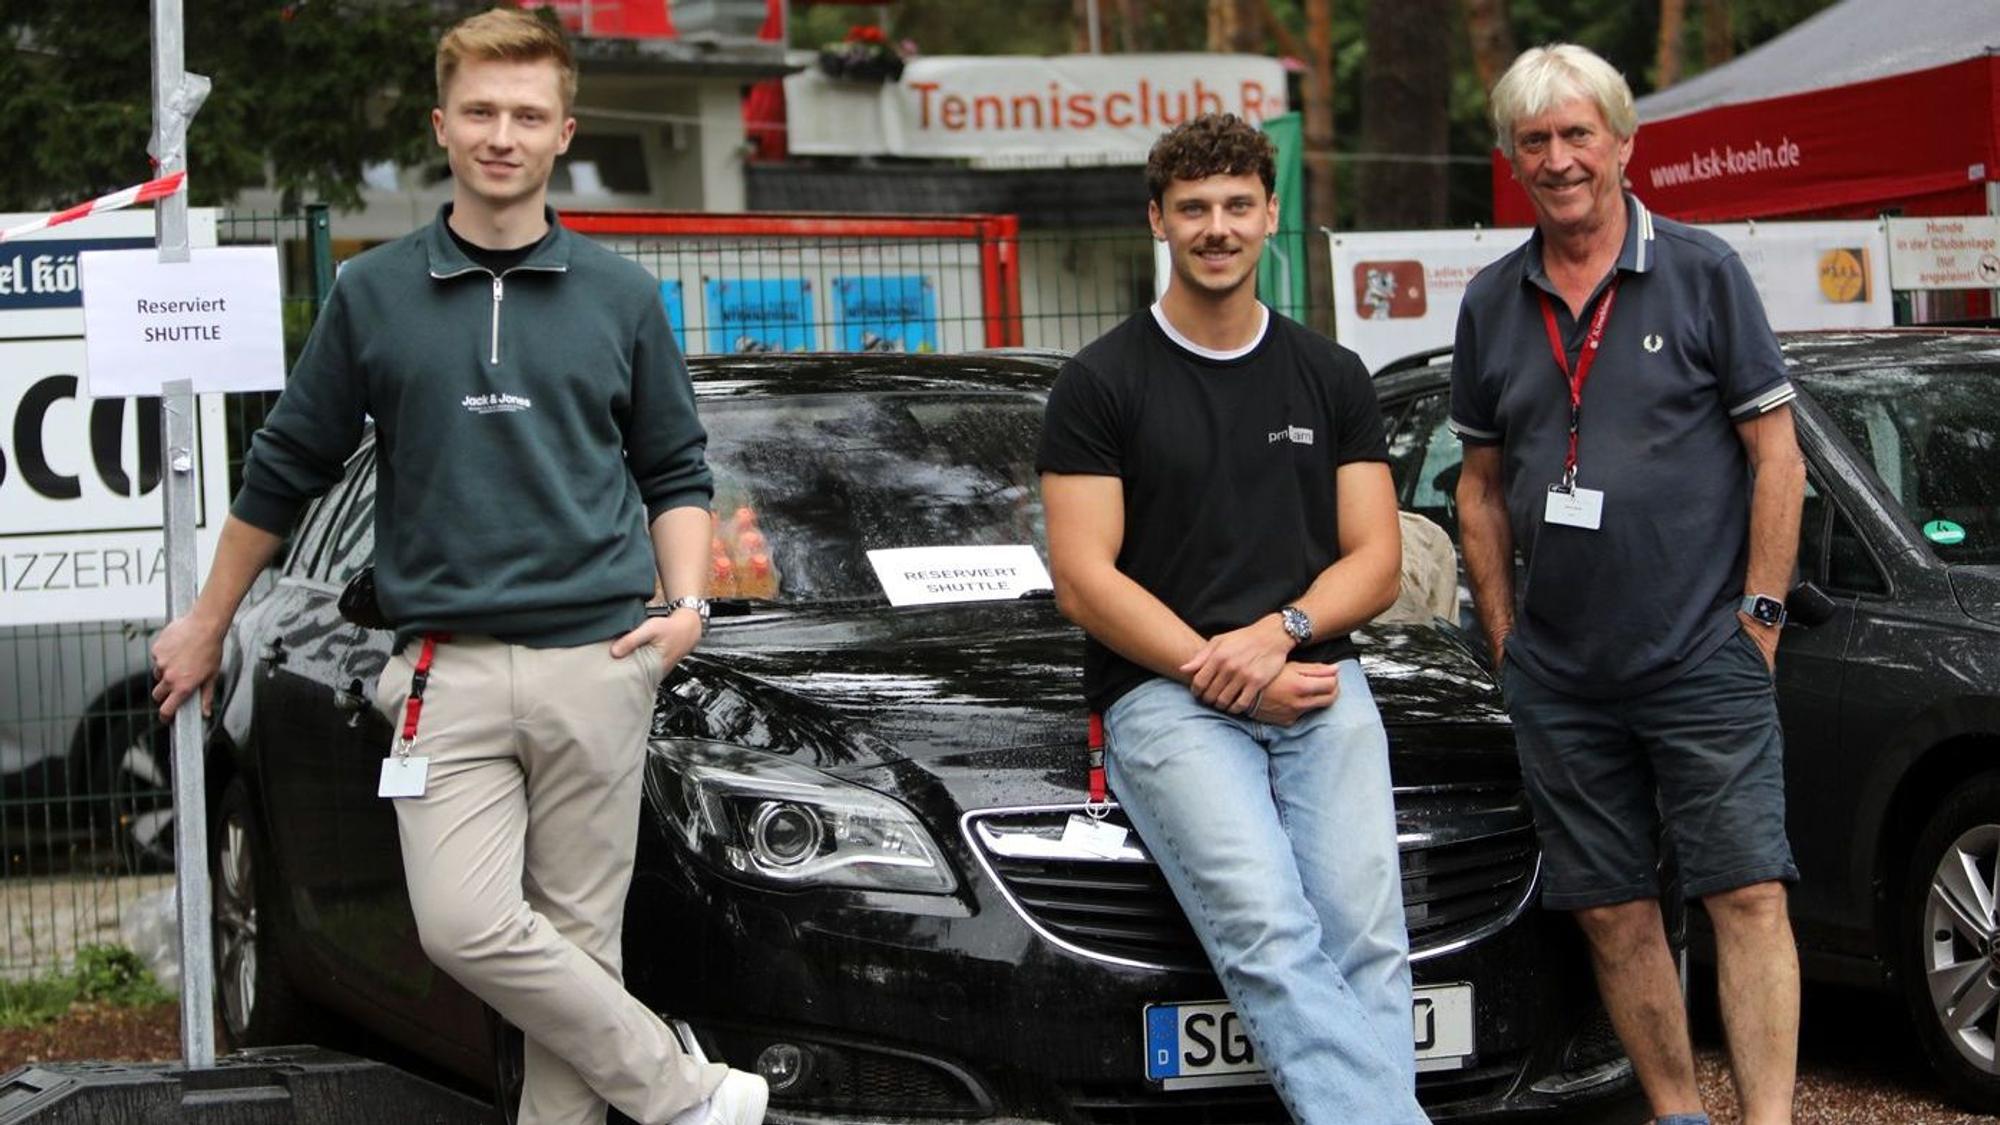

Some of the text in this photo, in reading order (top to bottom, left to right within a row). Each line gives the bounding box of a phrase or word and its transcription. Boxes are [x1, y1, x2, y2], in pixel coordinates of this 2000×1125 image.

[908, 79, 1222, 131] Tennisclub
[1650, 136, 1800, 188] www.ksk-koeln.de
[1926, 222, 1964, 233] Hunde
[137, 297, 226, 314] Reserviert
[144, 325, 221, 342] SHUTTLE
[462, 394, 488, 406] Jack
[498, 393, 531, 407] Jones
[904, 567, 1017, 581] RESERVIERT
[926, 581, 1011, 593] SHUTTLE
[1184, 1011, 1254, 1067] SG
[1158, 1049, 1168, 1065] D
